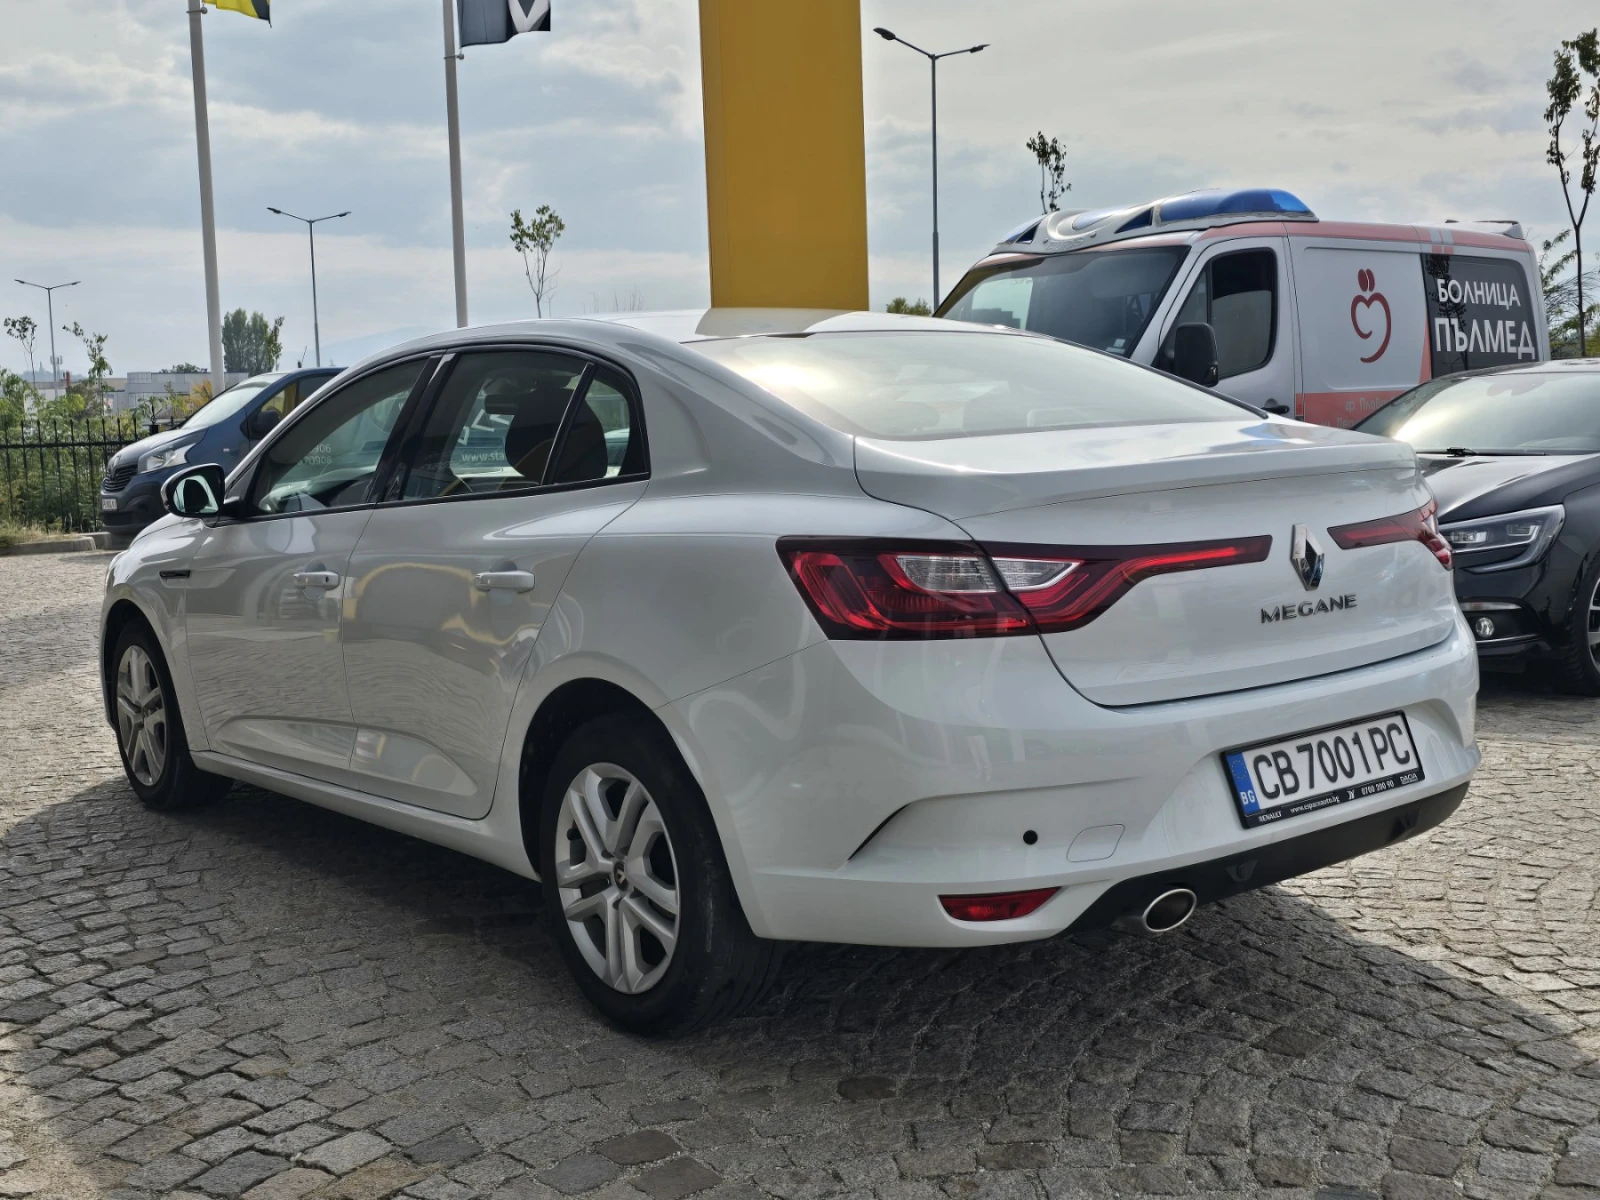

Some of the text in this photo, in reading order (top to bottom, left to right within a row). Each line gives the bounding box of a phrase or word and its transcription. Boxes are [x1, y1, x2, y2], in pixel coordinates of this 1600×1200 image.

[1436, 278, 1521, 311] БОЛНИЦА
[1434, 318, 1535, 360] ПЪЛМЕД
[1260, 594, 1358, 624] MEGANE
[1240, 789, 1255, 806] BG
[1258, 811, 1282, 822] RENAULT
[1400, 773, 1418, 785] DACIA
